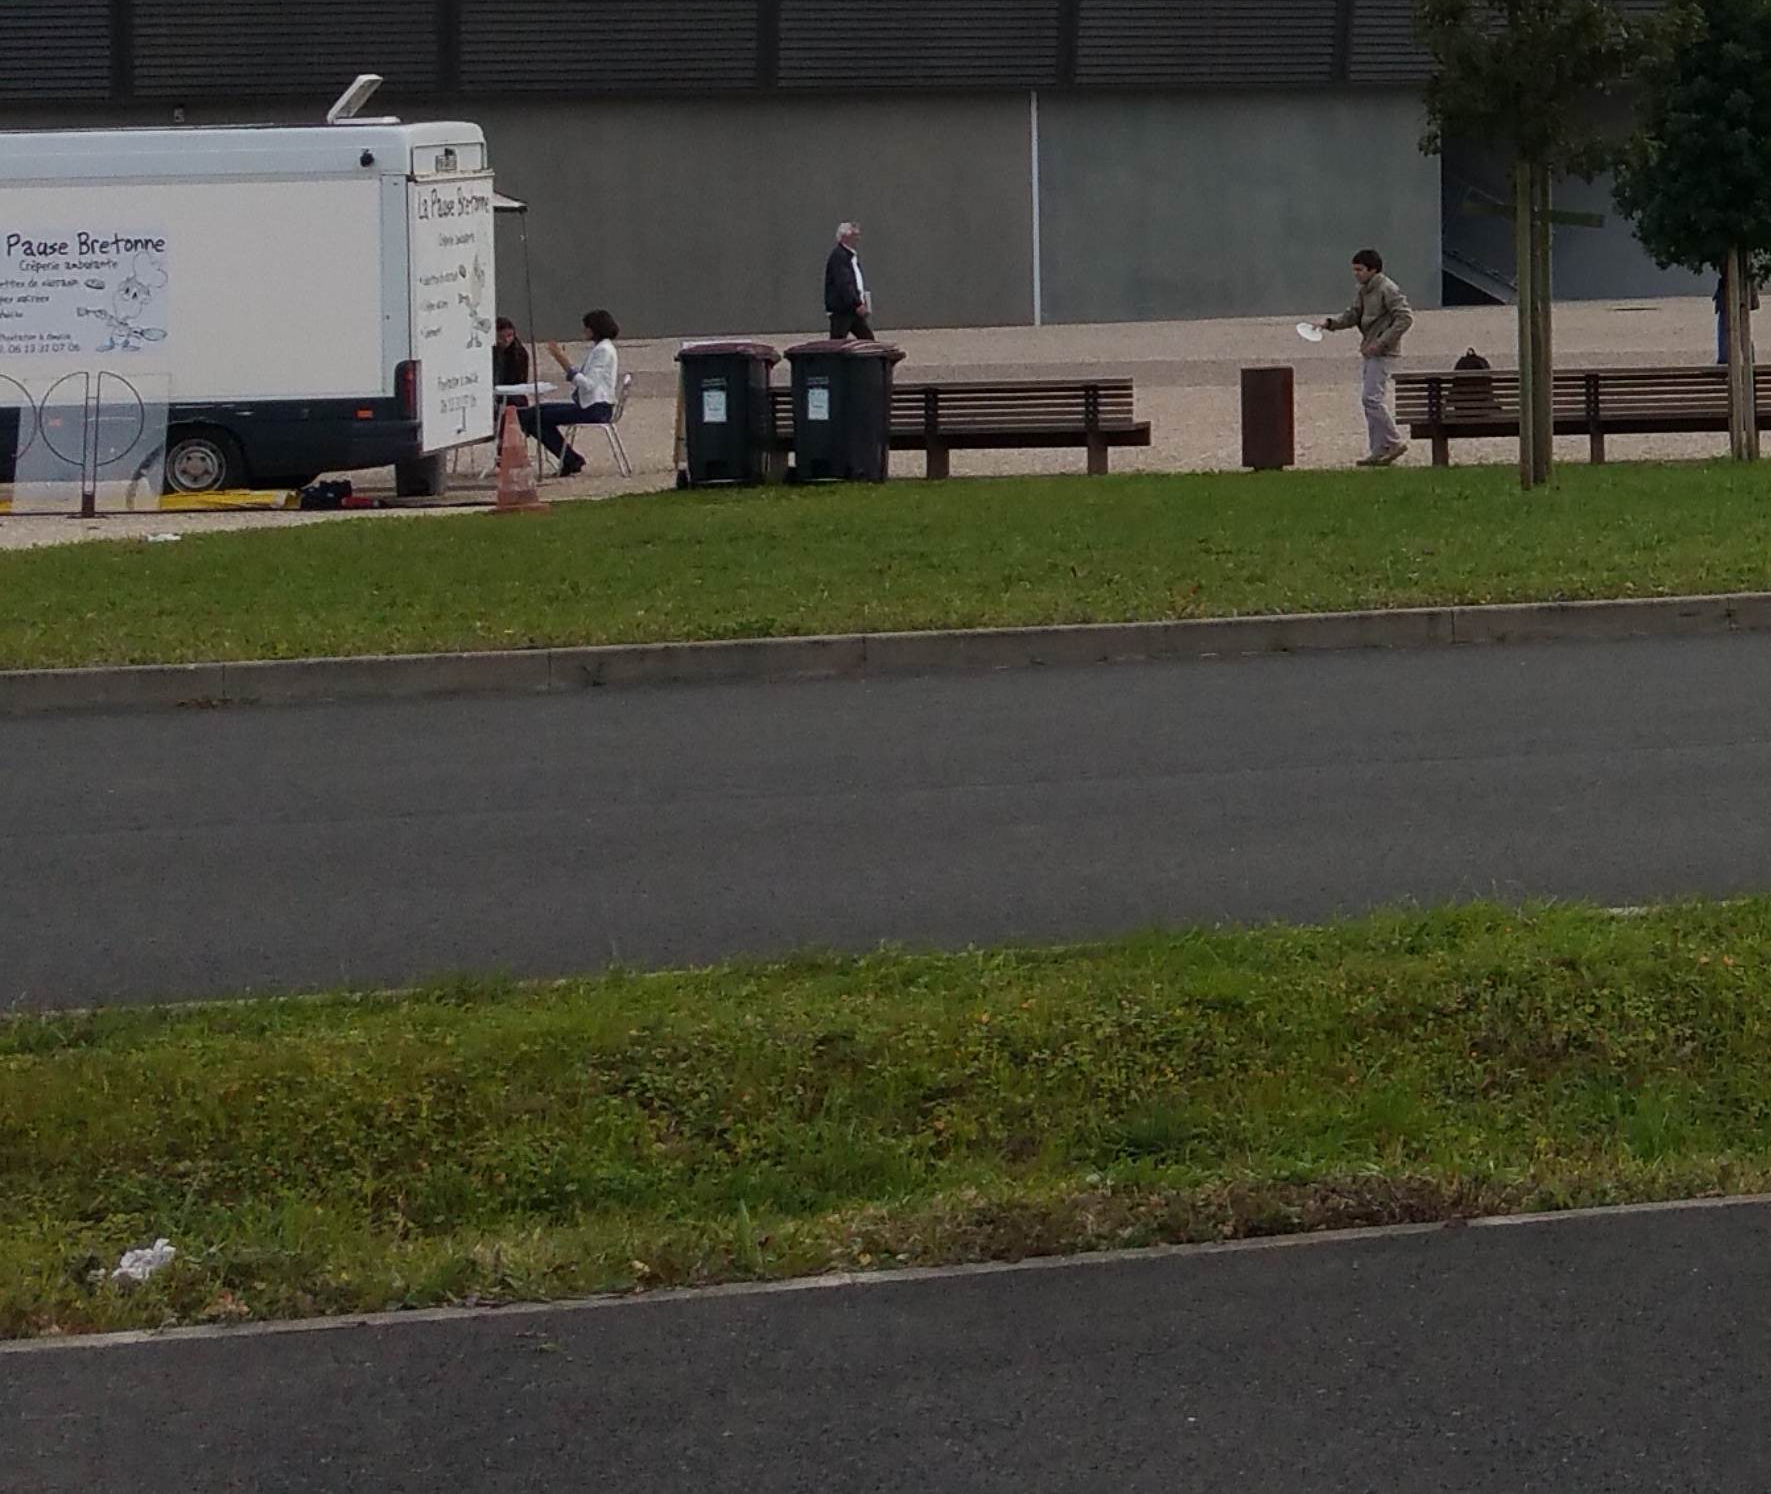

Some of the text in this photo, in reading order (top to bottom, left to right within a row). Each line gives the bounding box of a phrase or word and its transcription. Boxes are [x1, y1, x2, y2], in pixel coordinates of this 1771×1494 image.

[7, 231, 165, 256] Pause Bretonne
[19, 259, 60, 273] Crêperie
